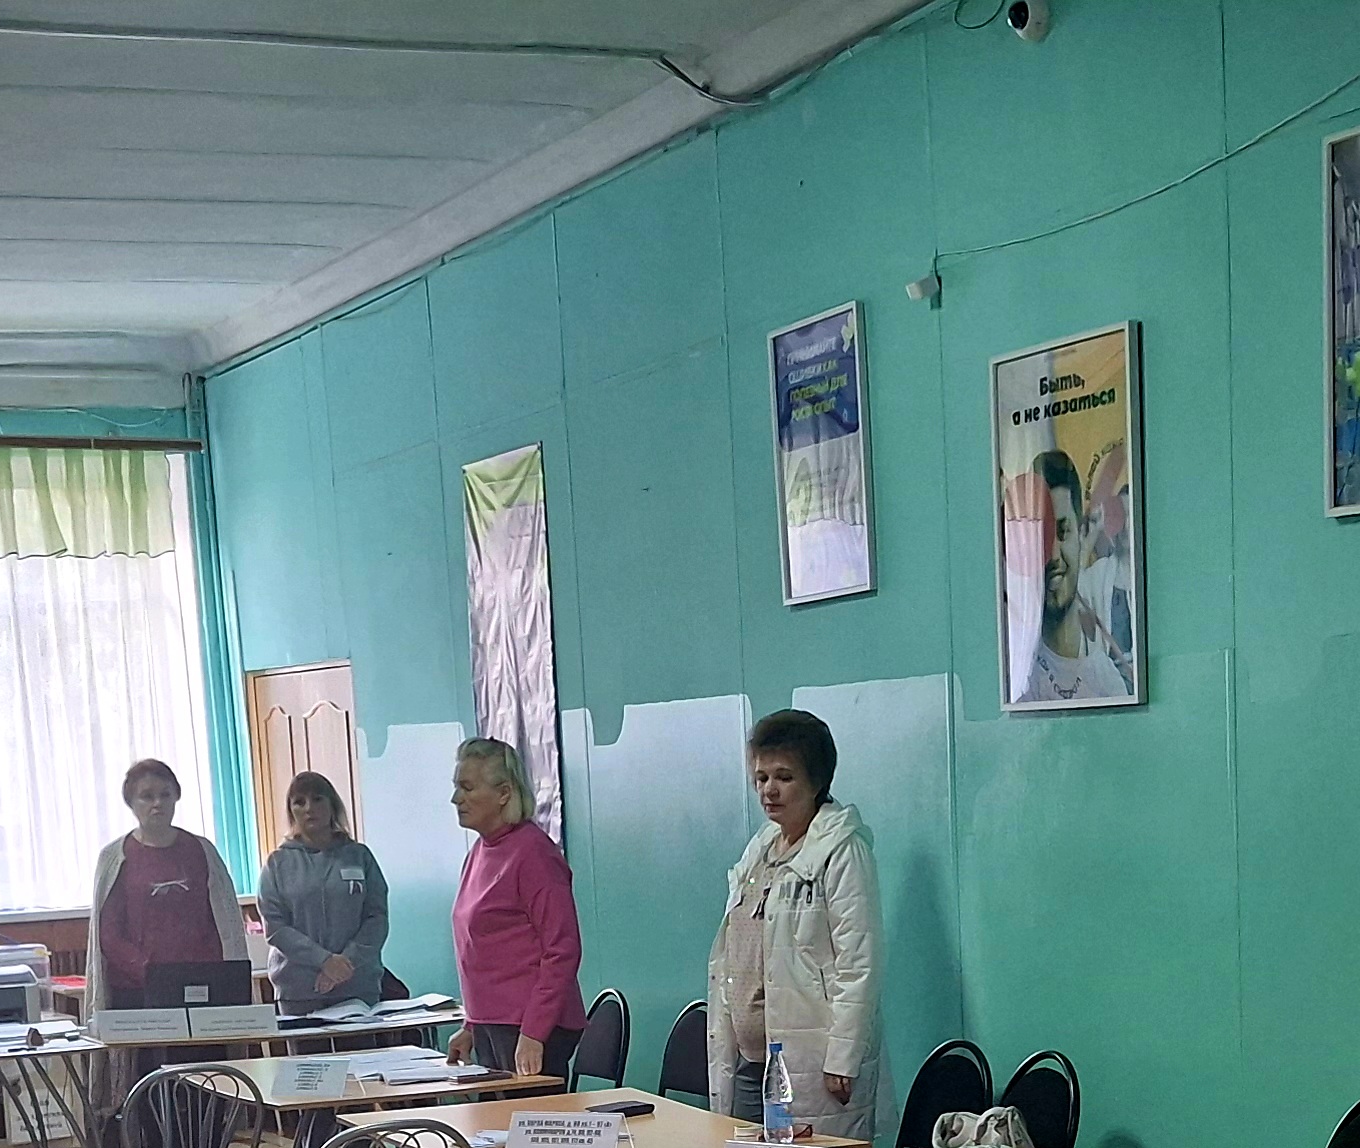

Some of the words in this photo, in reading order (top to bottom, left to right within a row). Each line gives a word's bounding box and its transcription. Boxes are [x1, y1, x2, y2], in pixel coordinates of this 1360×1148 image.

[1039, 373, 1086, 397] Быть,
[1012, 411, 1020, 426] а
[1024, 406, 1040, 424] не
[1044, 388, 1116, 419] казаться
